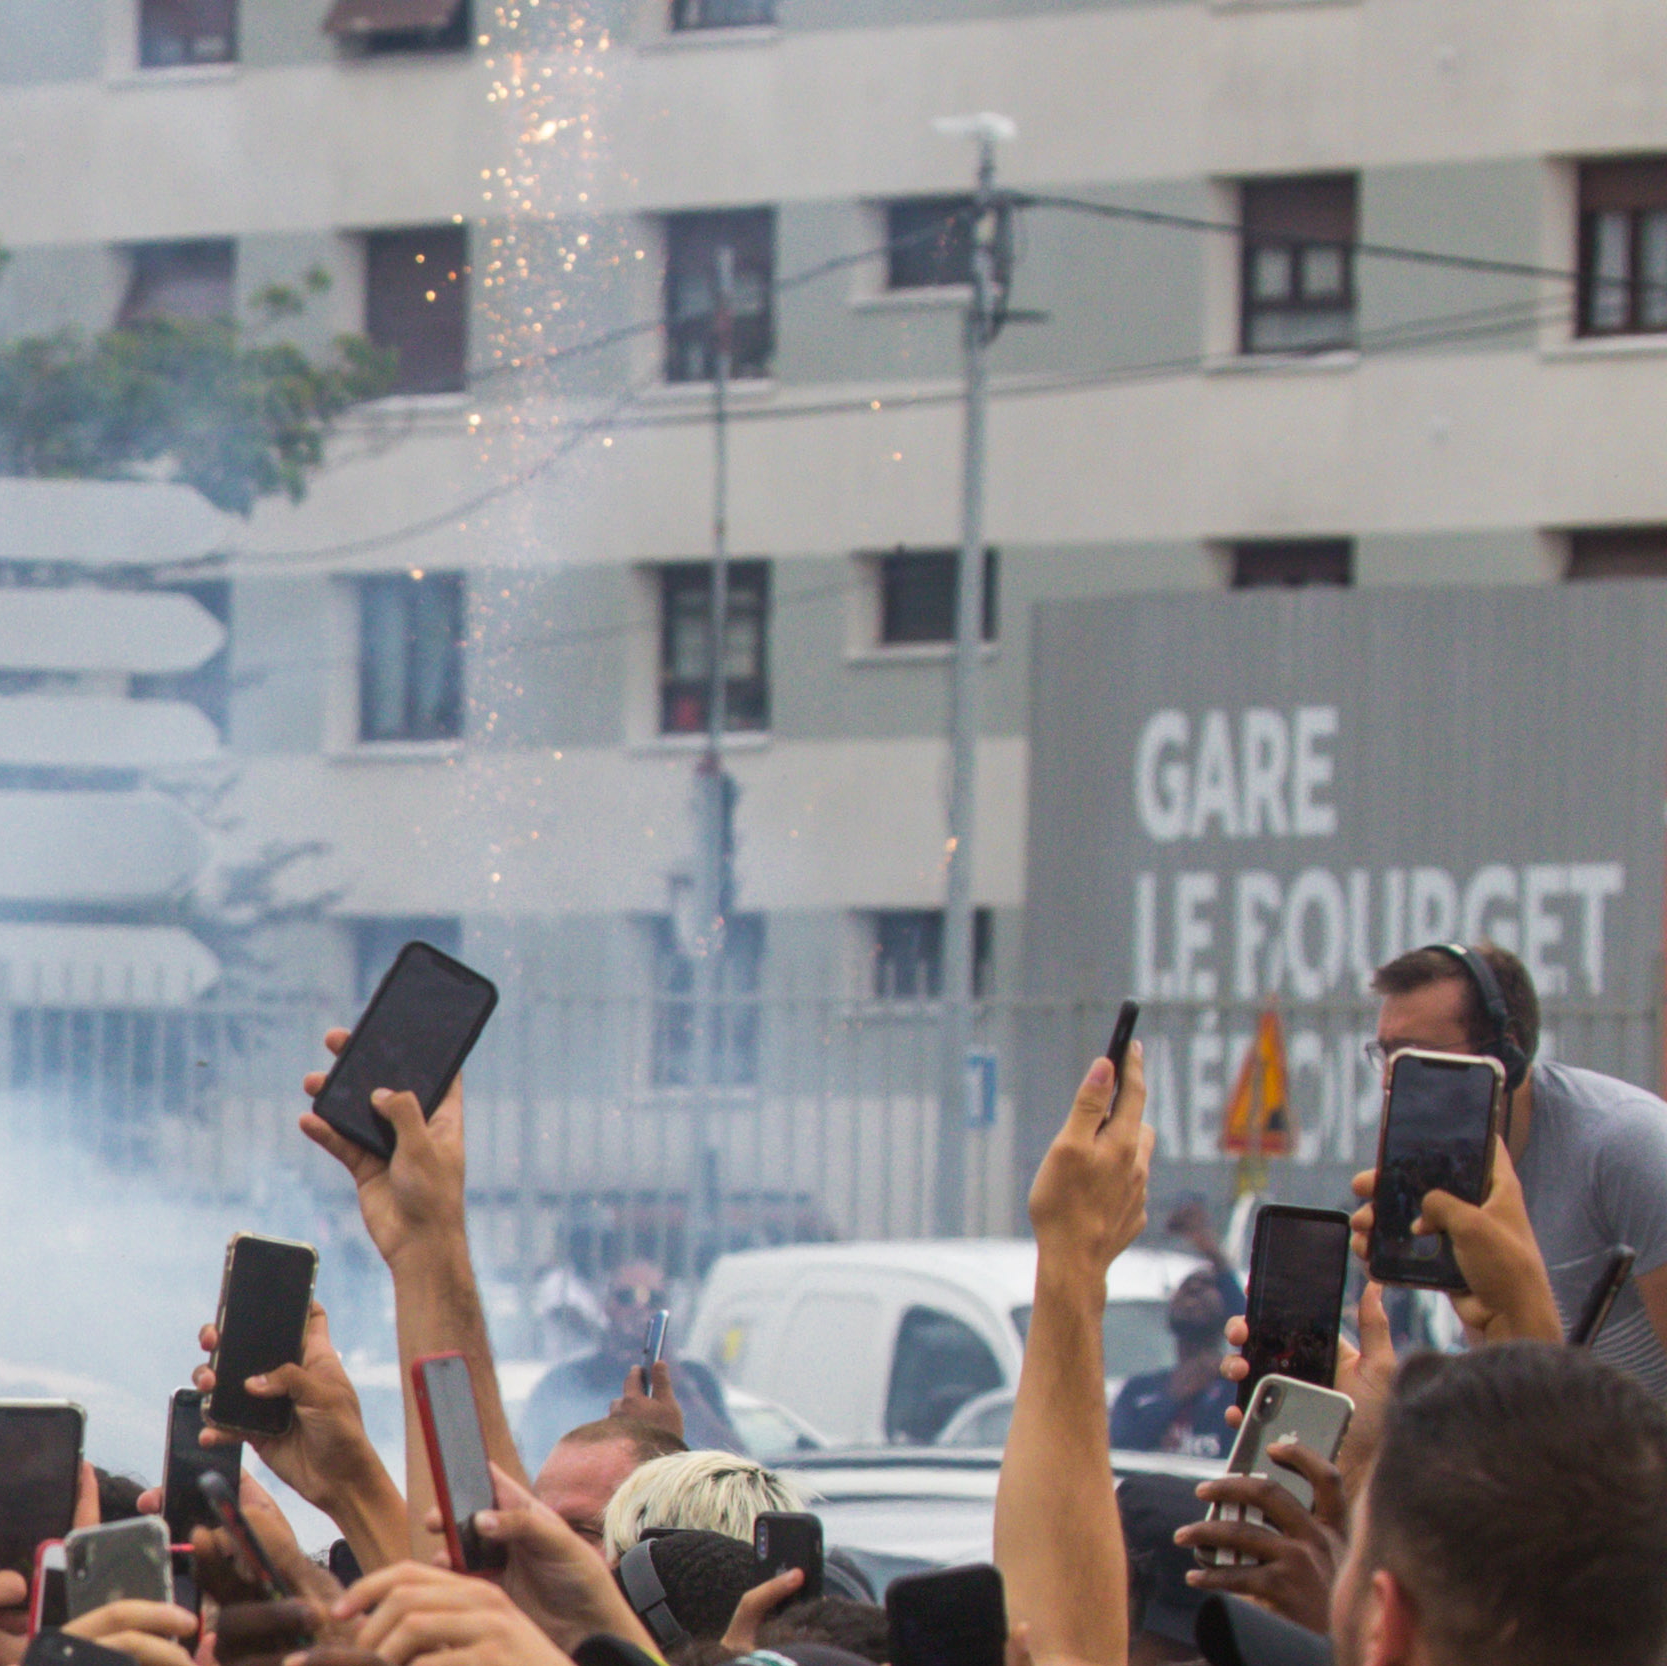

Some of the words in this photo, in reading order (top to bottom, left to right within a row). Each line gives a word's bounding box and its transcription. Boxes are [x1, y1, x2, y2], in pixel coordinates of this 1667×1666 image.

[1134, 706, 1339, 843] GARE
[1133, 872, 1218, 1001] LE
[1234, 862, 1626, 1001] BOURGET
